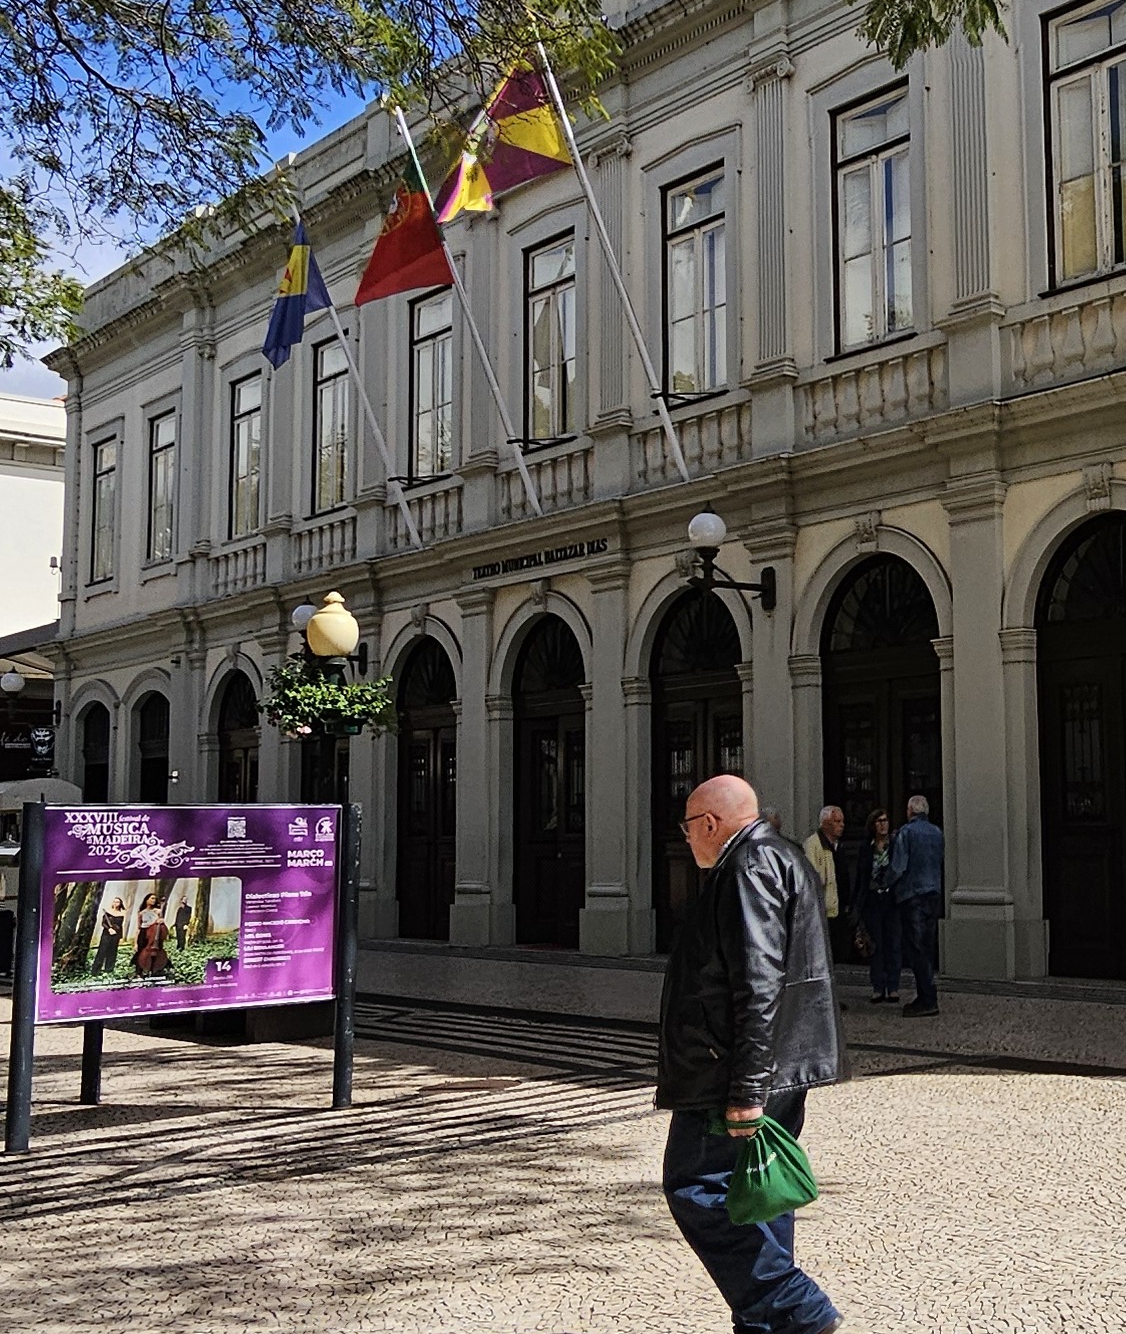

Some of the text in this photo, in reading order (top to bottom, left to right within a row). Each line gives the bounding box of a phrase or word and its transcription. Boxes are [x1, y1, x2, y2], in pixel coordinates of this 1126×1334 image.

[473, 562, 500, 580] TEATRO
[544, 542, 586, 564] BALTAZAR
[587, 537, 608, 555] DIAS
[64, 812, 119, 823] XXXVIII
[93, 835, 148, 845] MADEIRA
[88, 845, 120, 856] 2025
[215, 960, 232, 972] 14
